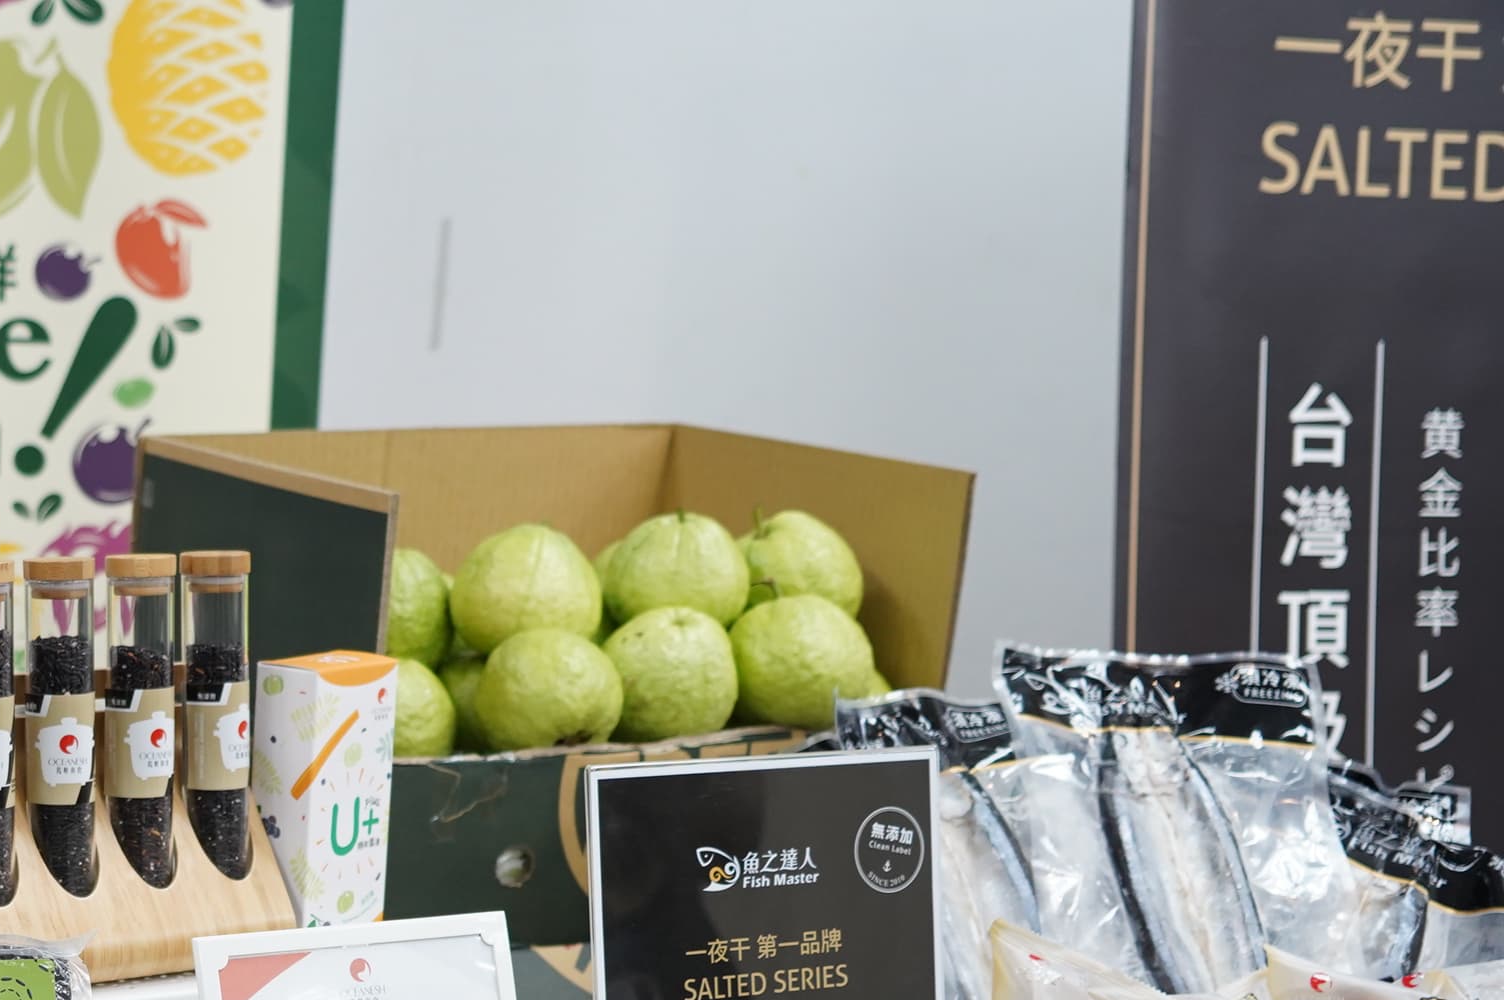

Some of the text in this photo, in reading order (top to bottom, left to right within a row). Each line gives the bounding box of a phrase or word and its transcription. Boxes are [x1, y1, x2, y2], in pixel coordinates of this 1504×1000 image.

[1273, 10, 1483, 92] 一夜干
[1259, 121, 1504, 203] SALTED
[868, 840, 912, 855] Clean Label
[870, 822, 914, 845] 無添加
[742, 847, 817, 874] 魚之達人
[743, 871, 819, 889] Fish Master
[686, 928, 842, 964] 一夜干 第一品牌
[773, 964, 849, 993] SERIES
